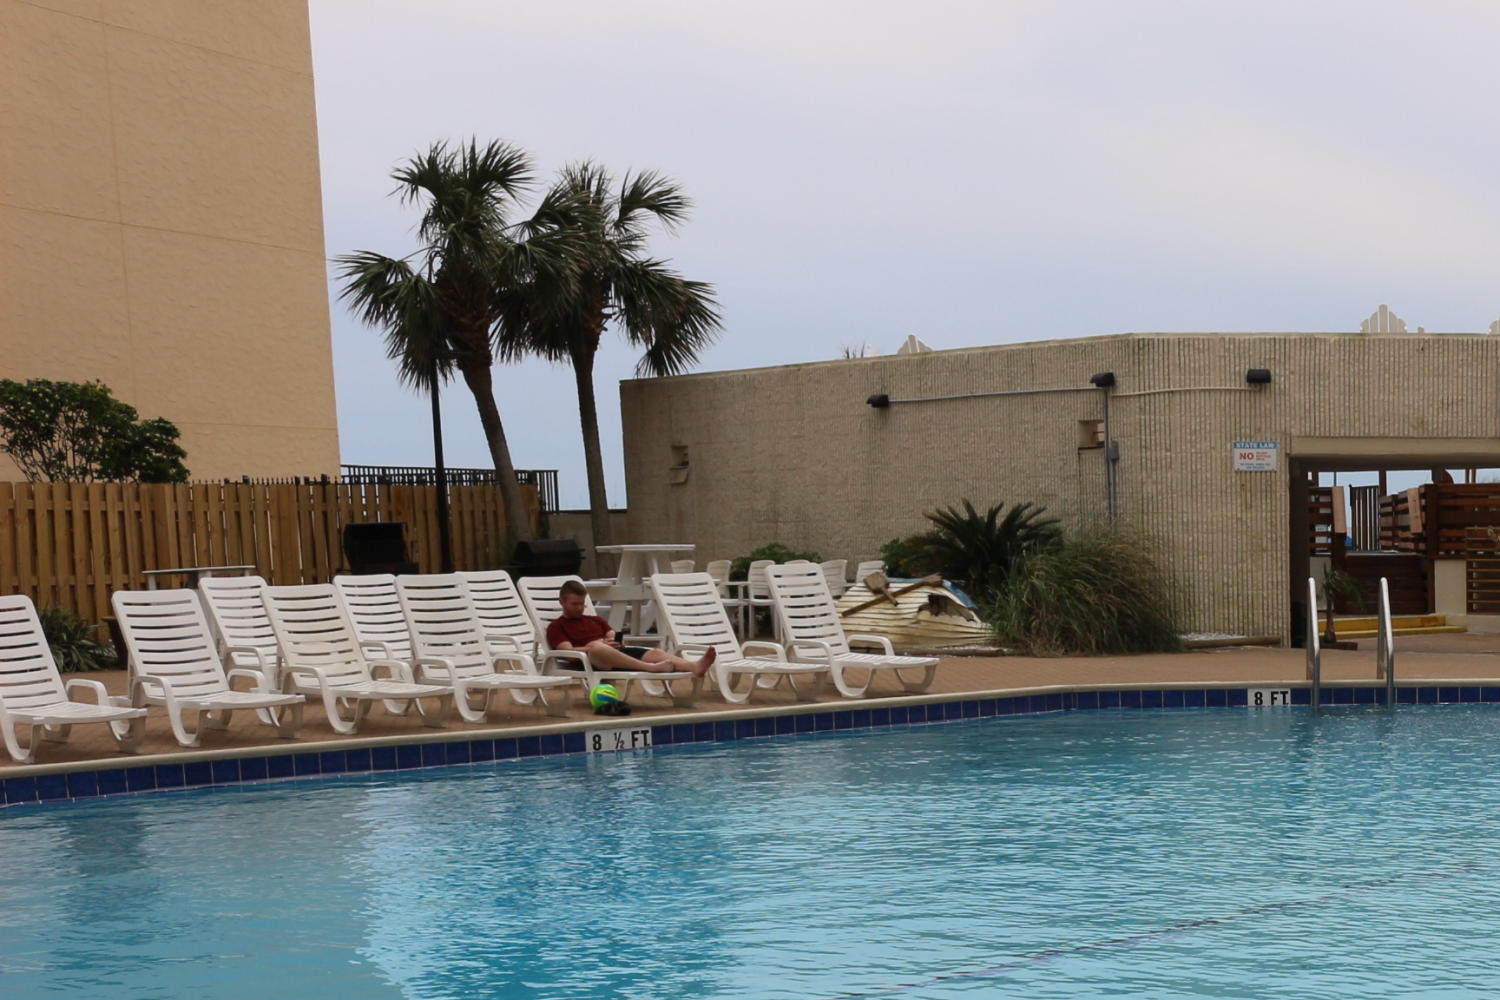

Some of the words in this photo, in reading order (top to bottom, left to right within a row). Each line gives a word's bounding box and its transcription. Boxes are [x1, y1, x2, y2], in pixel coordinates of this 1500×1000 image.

[1239, 452, 1254, 460] NO
[1254, 691, 1263, 706] 8
[592, 734, 602, 751] 8
